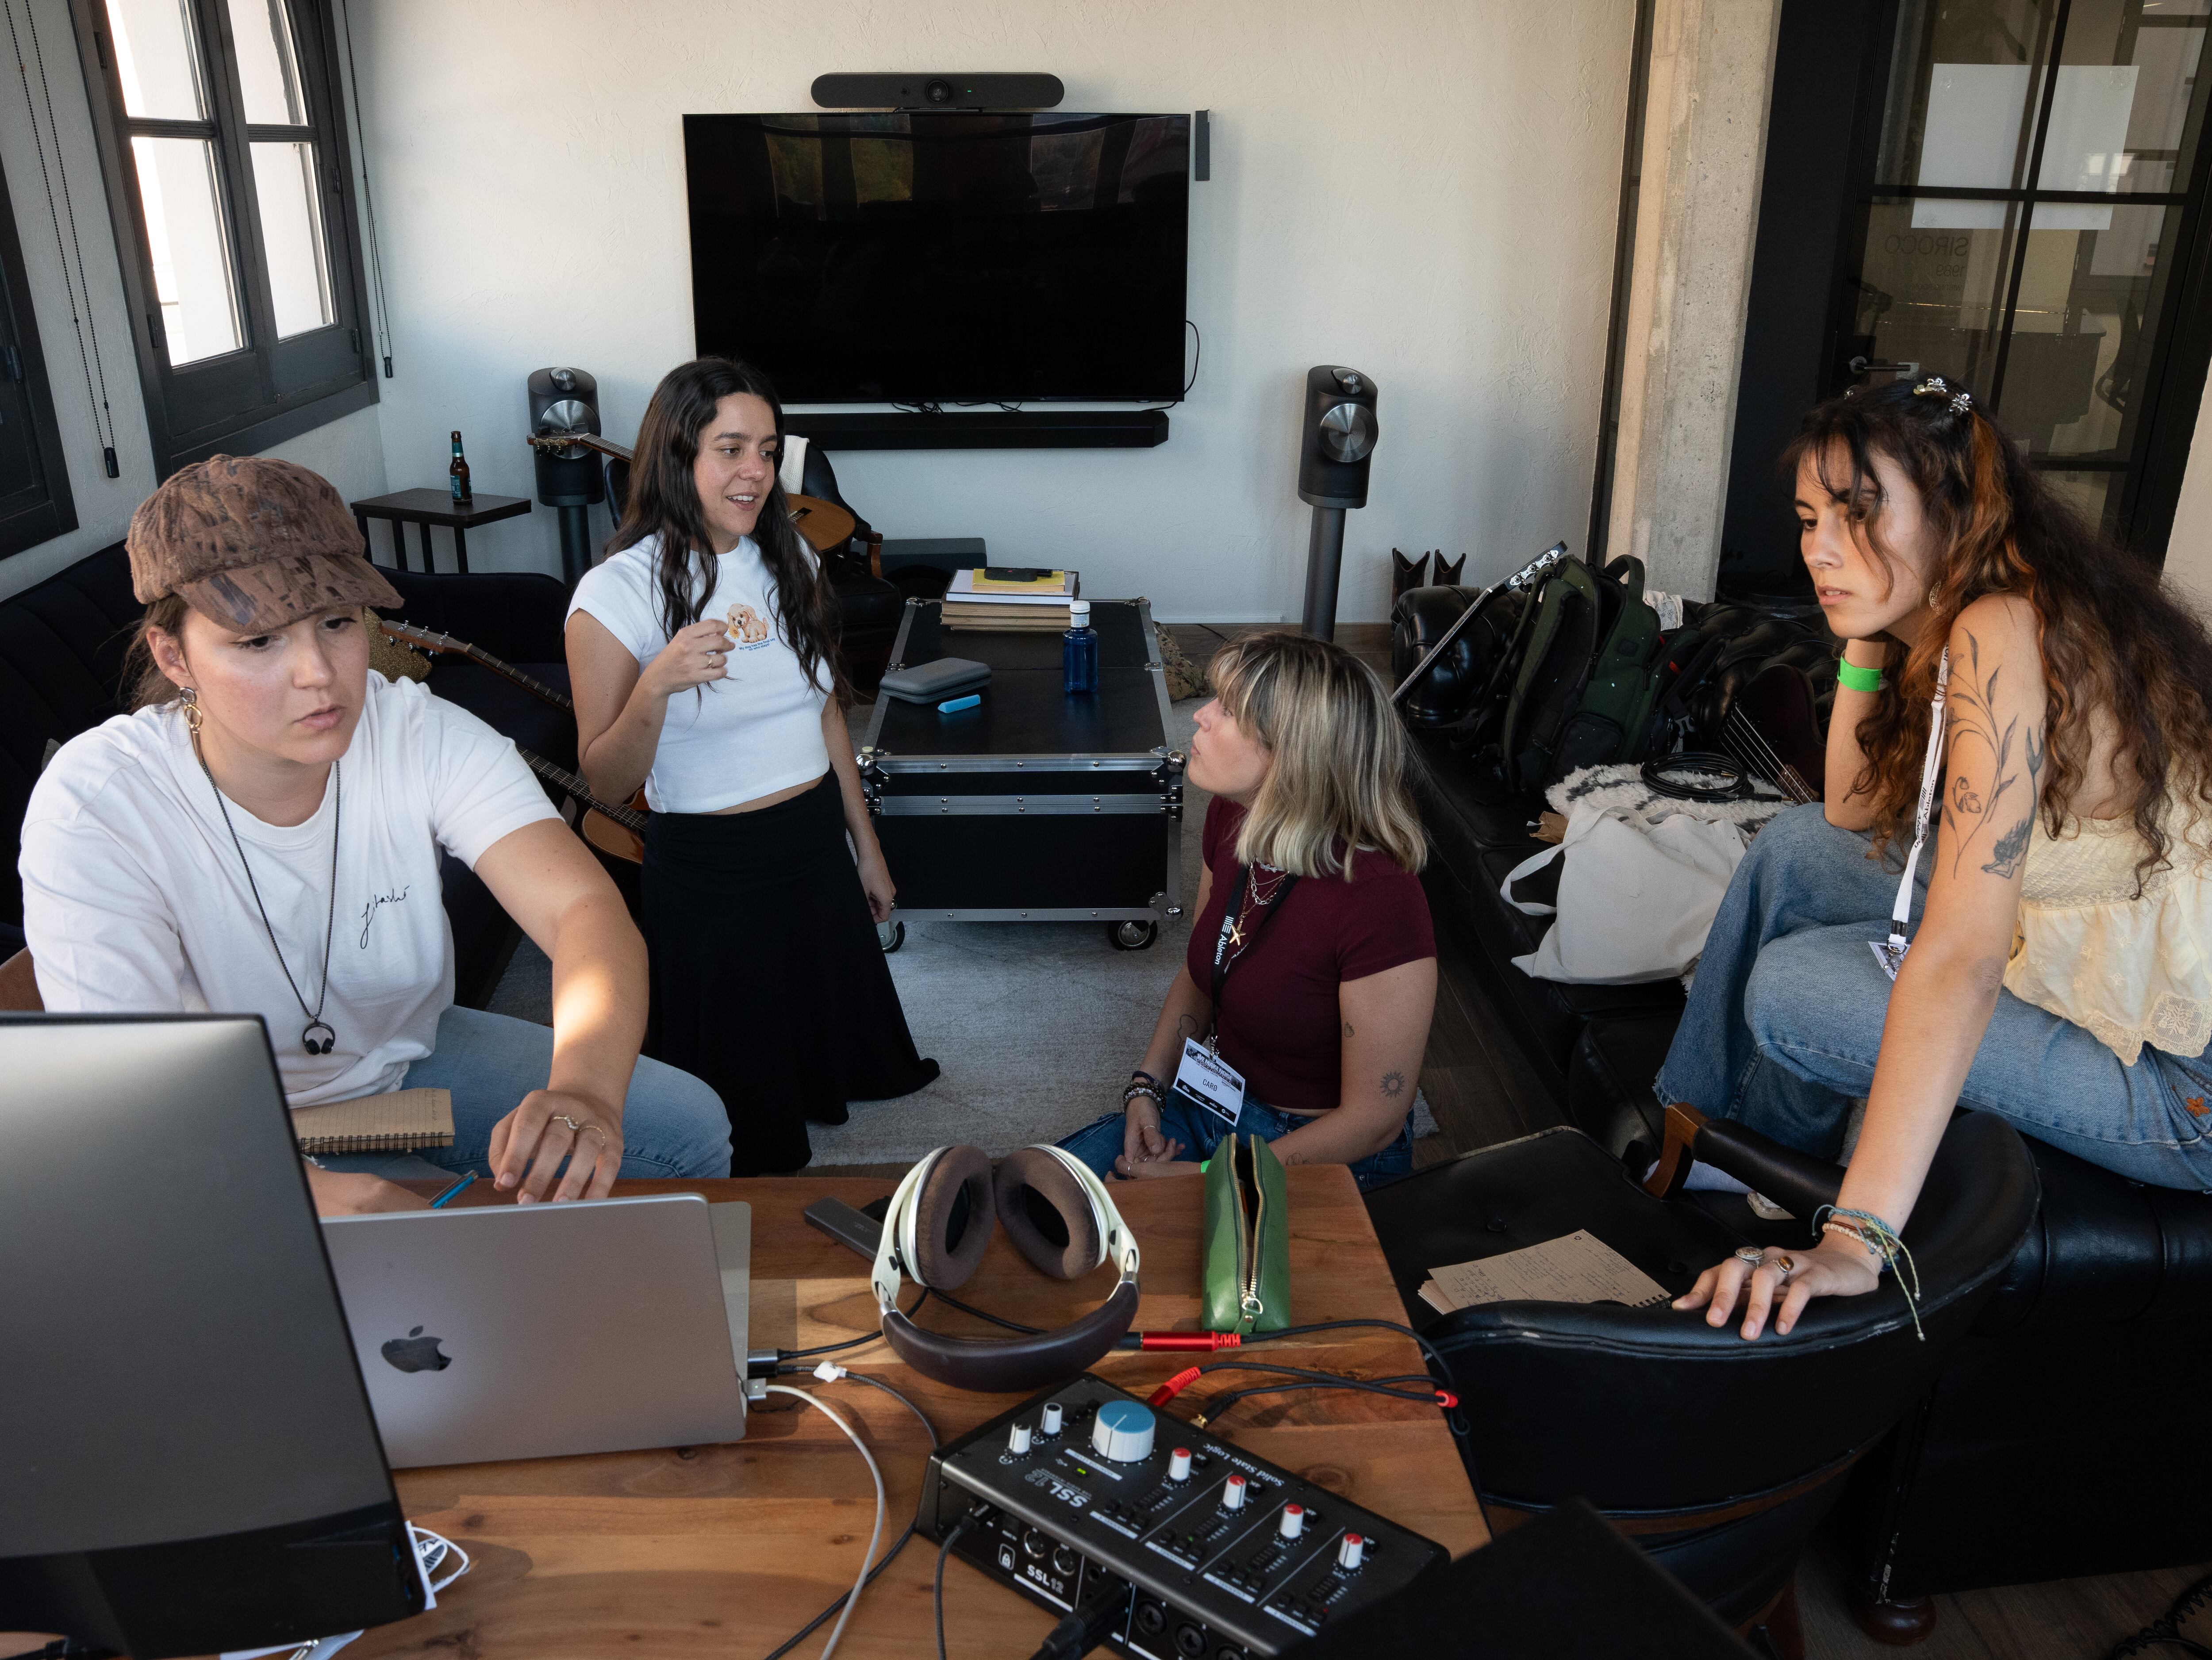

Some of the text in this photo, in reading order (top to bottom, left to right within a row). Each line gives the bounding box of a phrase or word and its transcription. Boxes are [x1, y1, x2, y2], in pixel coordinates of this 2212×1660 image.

[1923, 780, 1935, 820] Ableton
[1214, 934, 1228, 965] Ableton
[1196, 1058, 1216, 1073] SESSIONS
[1198, 1053, 1233, 1080] WE MAKE NOISE
[1203, 1443, 1284, 1488] Solid State Logic
